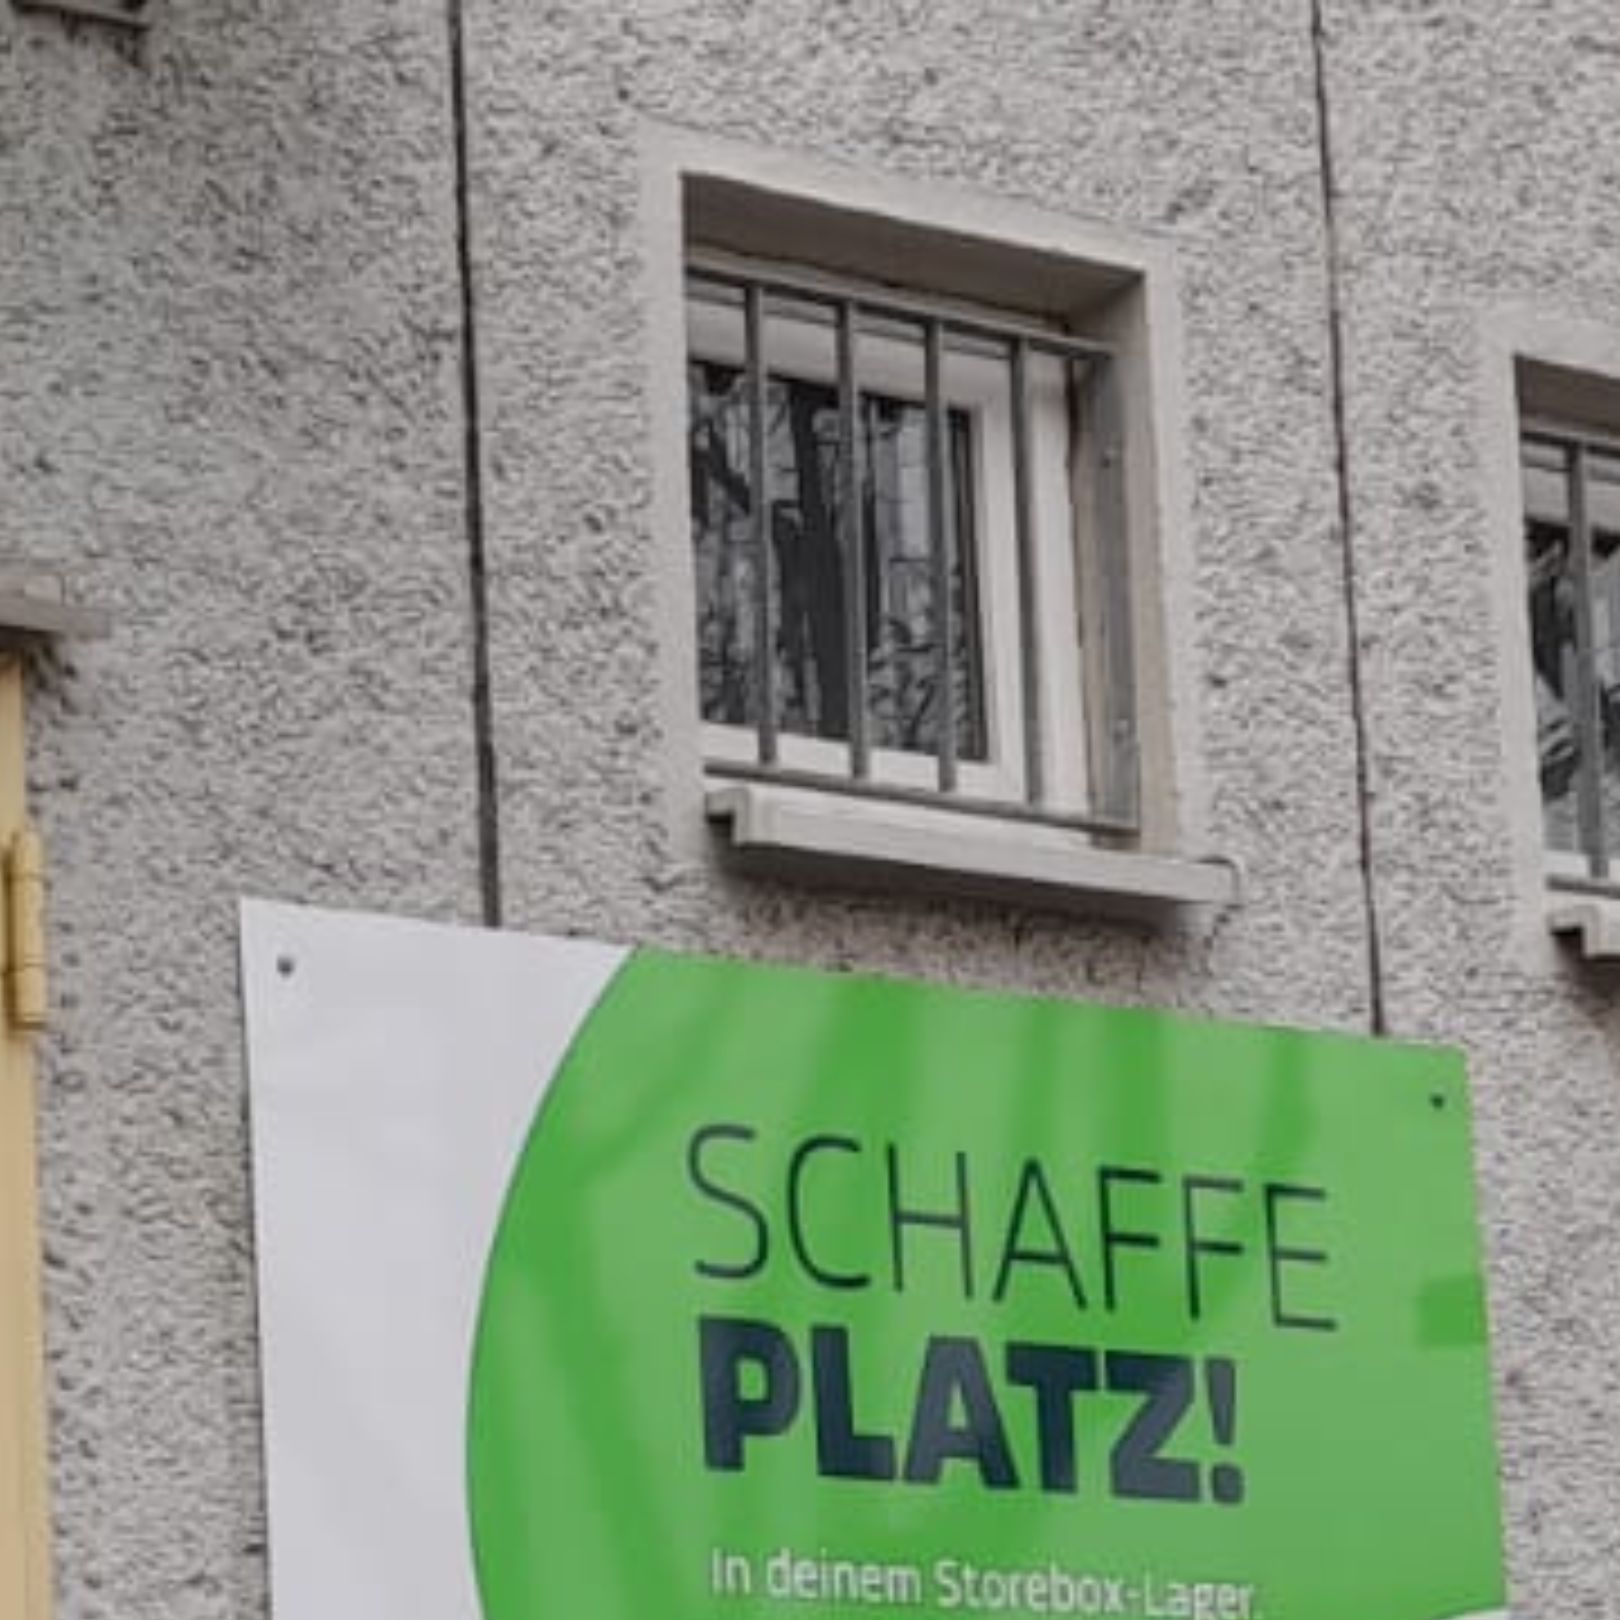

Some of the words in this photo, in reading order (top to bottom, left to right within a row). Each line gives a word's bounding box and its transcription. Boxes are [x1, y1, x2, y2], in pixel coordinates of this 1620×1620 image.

[686, 1123, 1338, 1331] SCHAFFE
[697, 1314, 1246, 1505] PLATZ!
[709, 1547, 751, 1594] In
[764, 1548, 923, 1604] deinem
